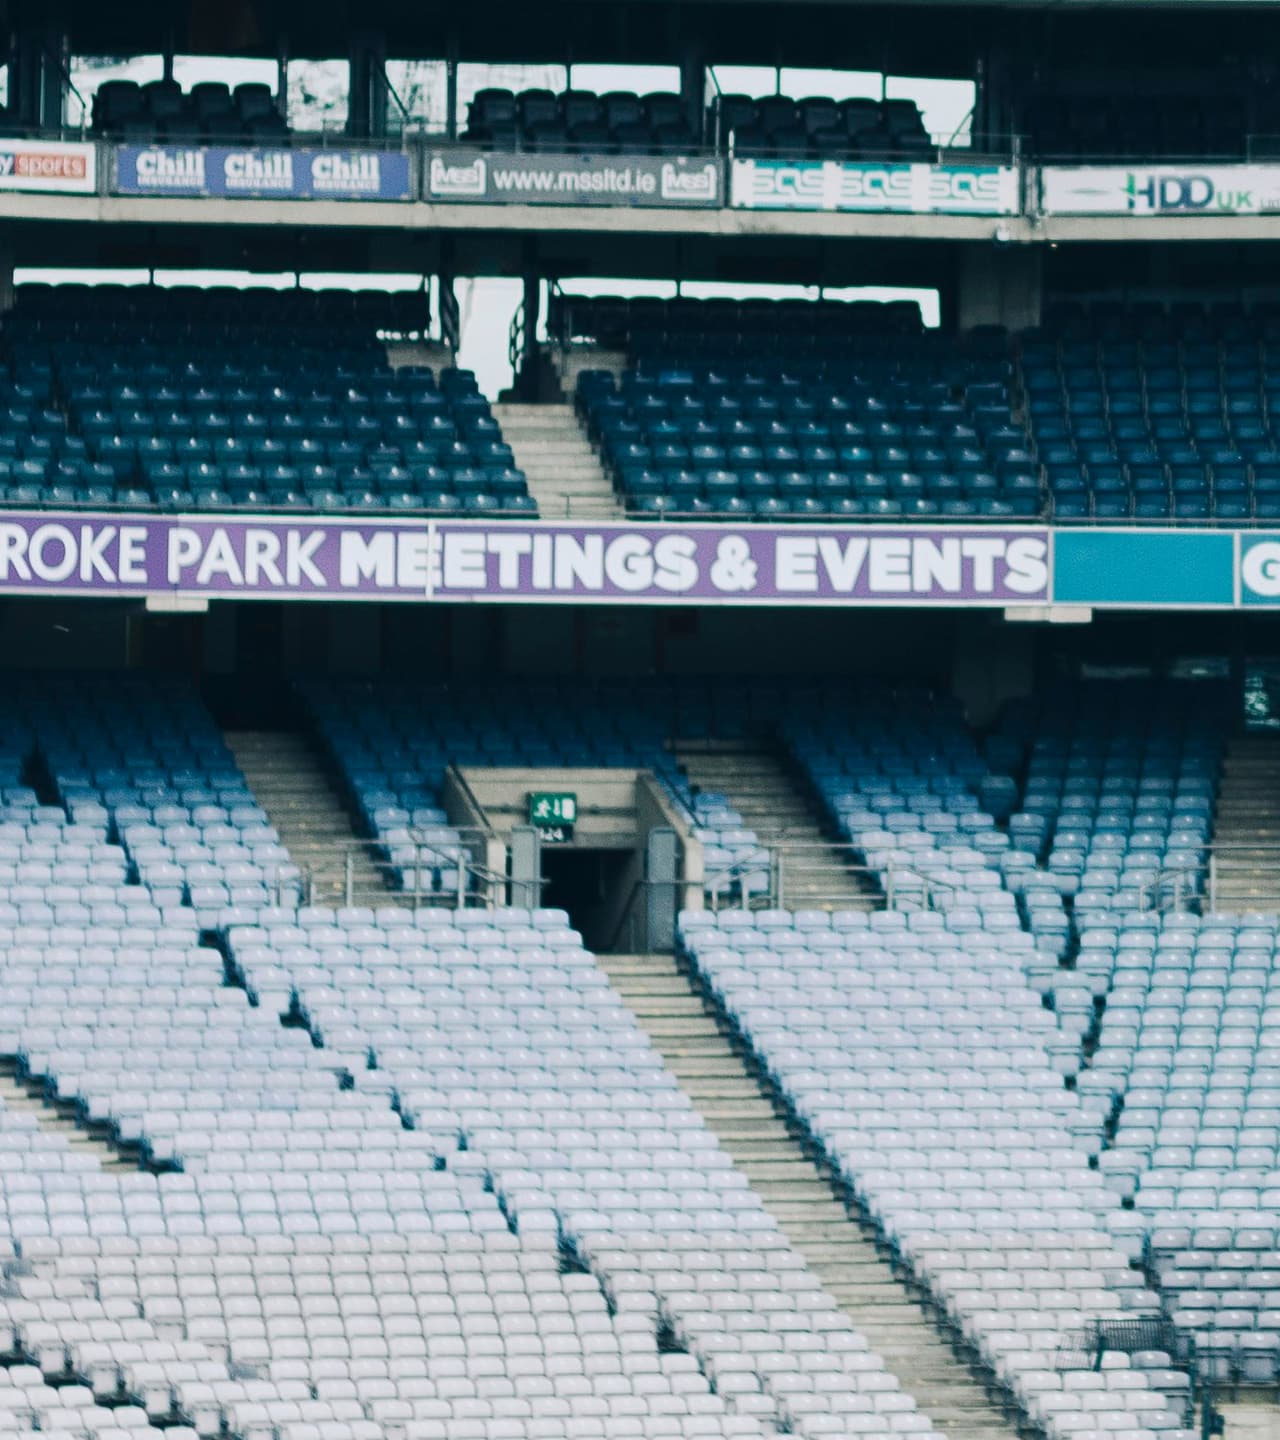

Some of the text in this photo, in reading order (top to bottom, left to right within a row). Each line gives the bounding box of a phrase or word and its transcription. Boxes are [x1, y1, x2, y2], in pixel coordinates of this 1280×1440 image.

[17, 155, 84, 177] sports
[136, 151, 204, 175] Chill
[224, 153, 292, 177] Chill
[311, 154, 379, 179] Chill
[493, 169, 656, 193] www.mssltd.ie
[1122, 172, 1214, 209] HDD
[1216, 191, 1253, 209] UK
[167, 527, 328, 587] PARK
[340, 530, 699, 592] MEETINGS
[710, 535, 757, 592] &
[775, 536, 1048, 594] EVENTS
